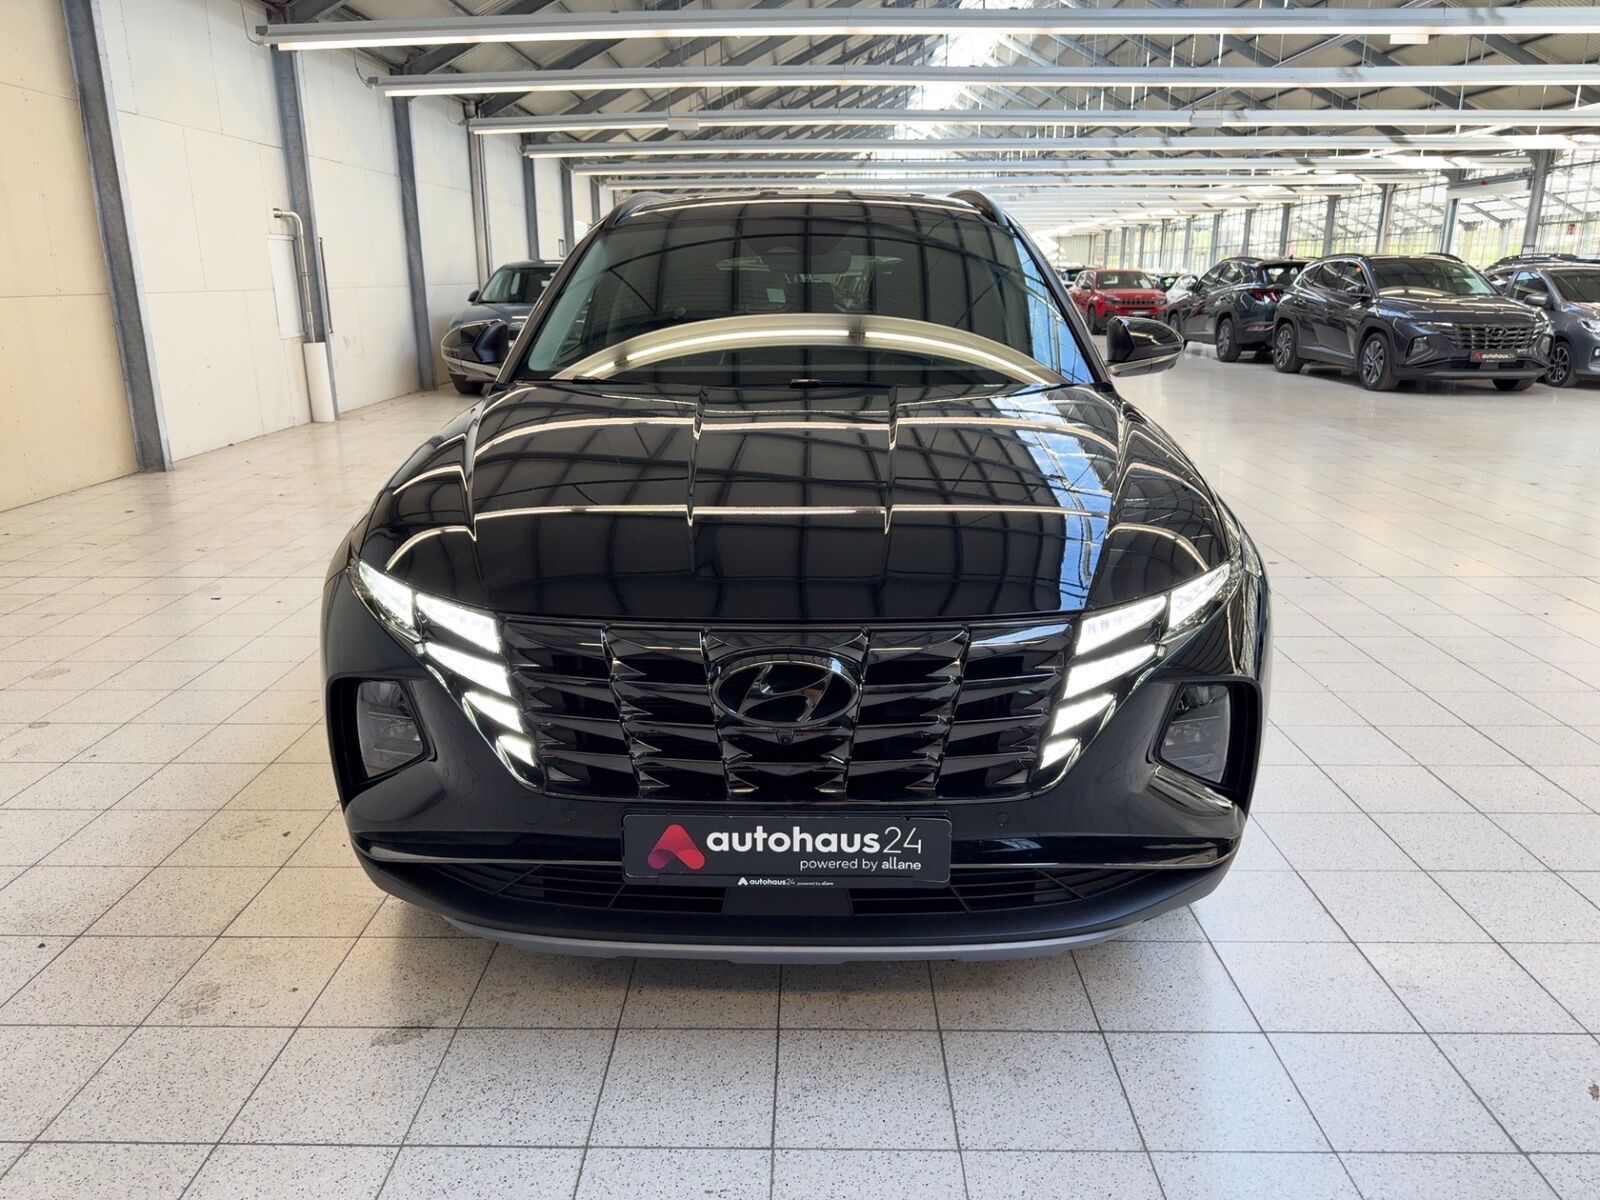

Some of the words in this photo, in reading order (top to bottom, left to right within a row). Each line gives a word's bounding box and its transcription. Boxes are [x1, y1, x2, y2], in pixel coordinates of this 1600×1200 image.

[706, 825, 922, 854] autohaus24
[799, 858, 858, 871] powered
[861, 858, 879, 872] by
[881, 858, 922, 871] allane
[749, 878, 795, 886] autohaus24
